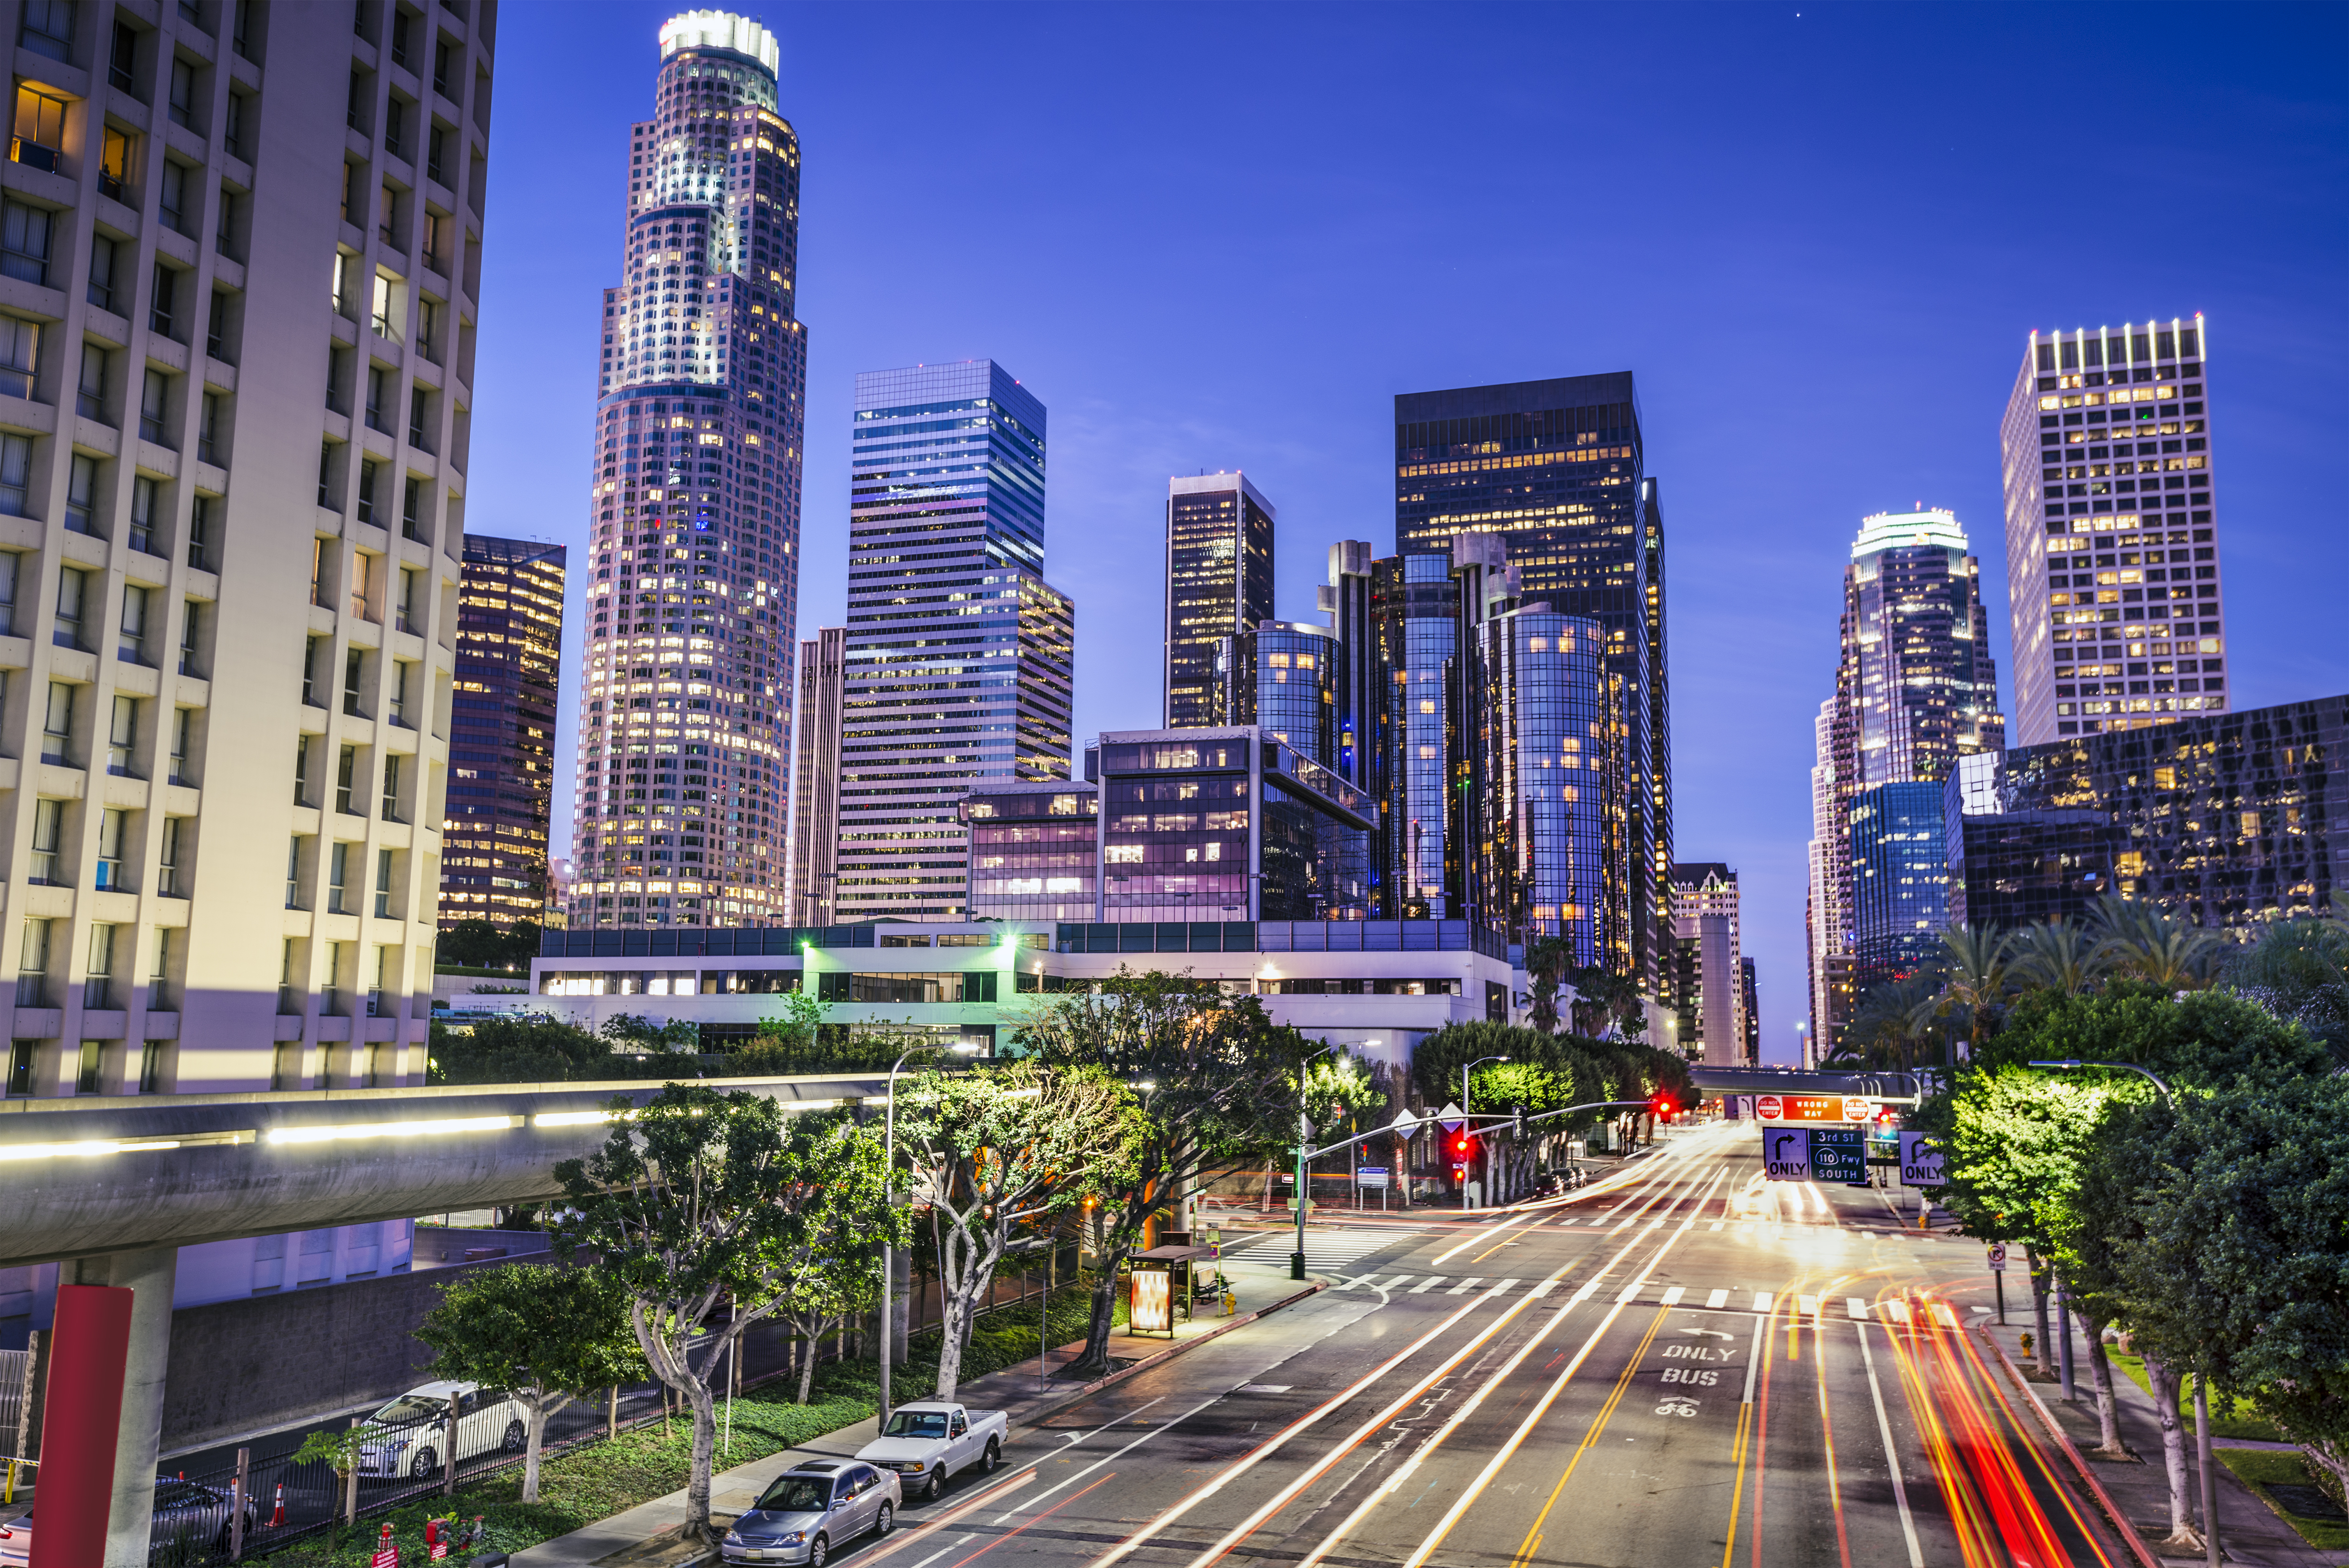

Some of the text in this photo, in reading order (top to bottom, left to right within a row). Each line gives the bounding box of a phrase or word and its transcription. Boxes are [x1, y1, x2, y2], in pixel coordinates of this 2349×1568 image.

[1819, 1132, 1854, 1142] 3rd ST
[1820, 1154, 1860, 1165] 110 Fwy
[1770, 1162, 1806, 1175] ONLY
[1819, 1169, 1857, 1179] SOUTH
[1906, 1166, 1943, 1179] ONLY
[1663, 1345, 1737, 1361] ONLY
[1660, 1368, 1719, 1386] BUS
